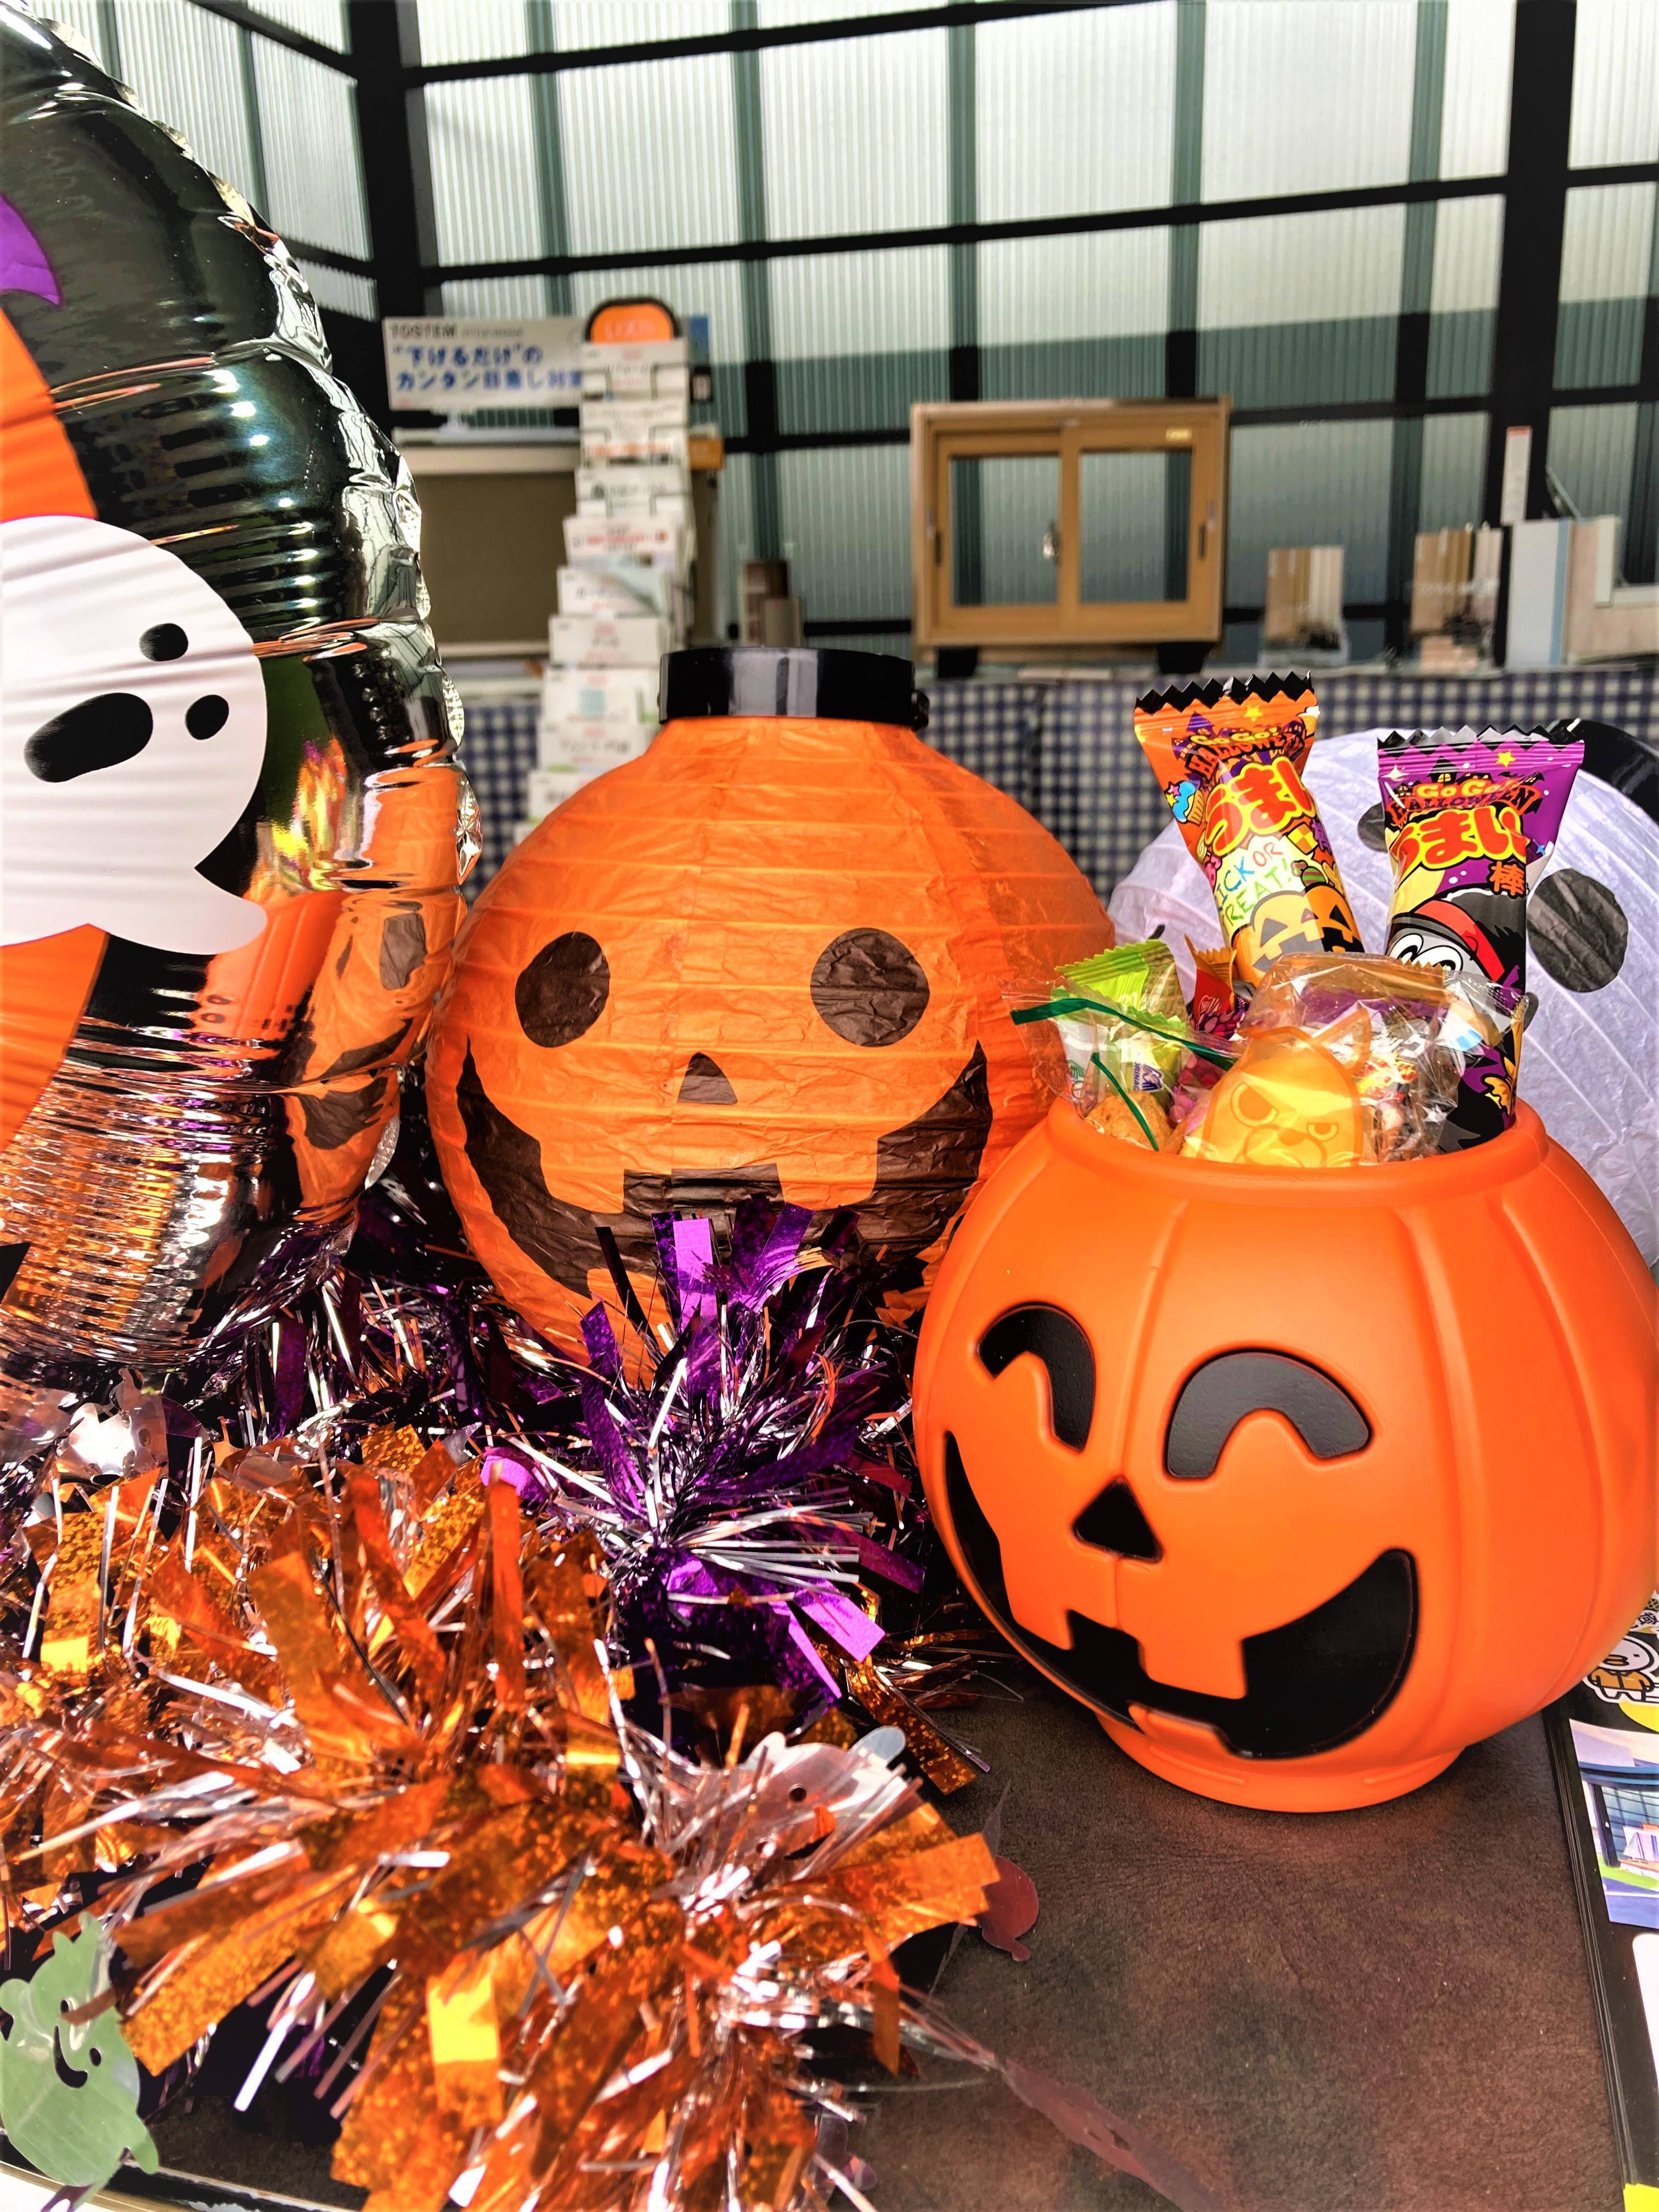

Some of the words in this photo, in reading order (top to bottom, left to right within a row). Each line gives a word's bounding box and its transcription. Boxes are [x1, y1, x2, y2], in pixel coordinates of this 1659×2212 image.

[1252, 841, 1283, 868] OR
[1390, 805, 1530, 891] うまい
[1488, 860, 1525, 896] 棒
